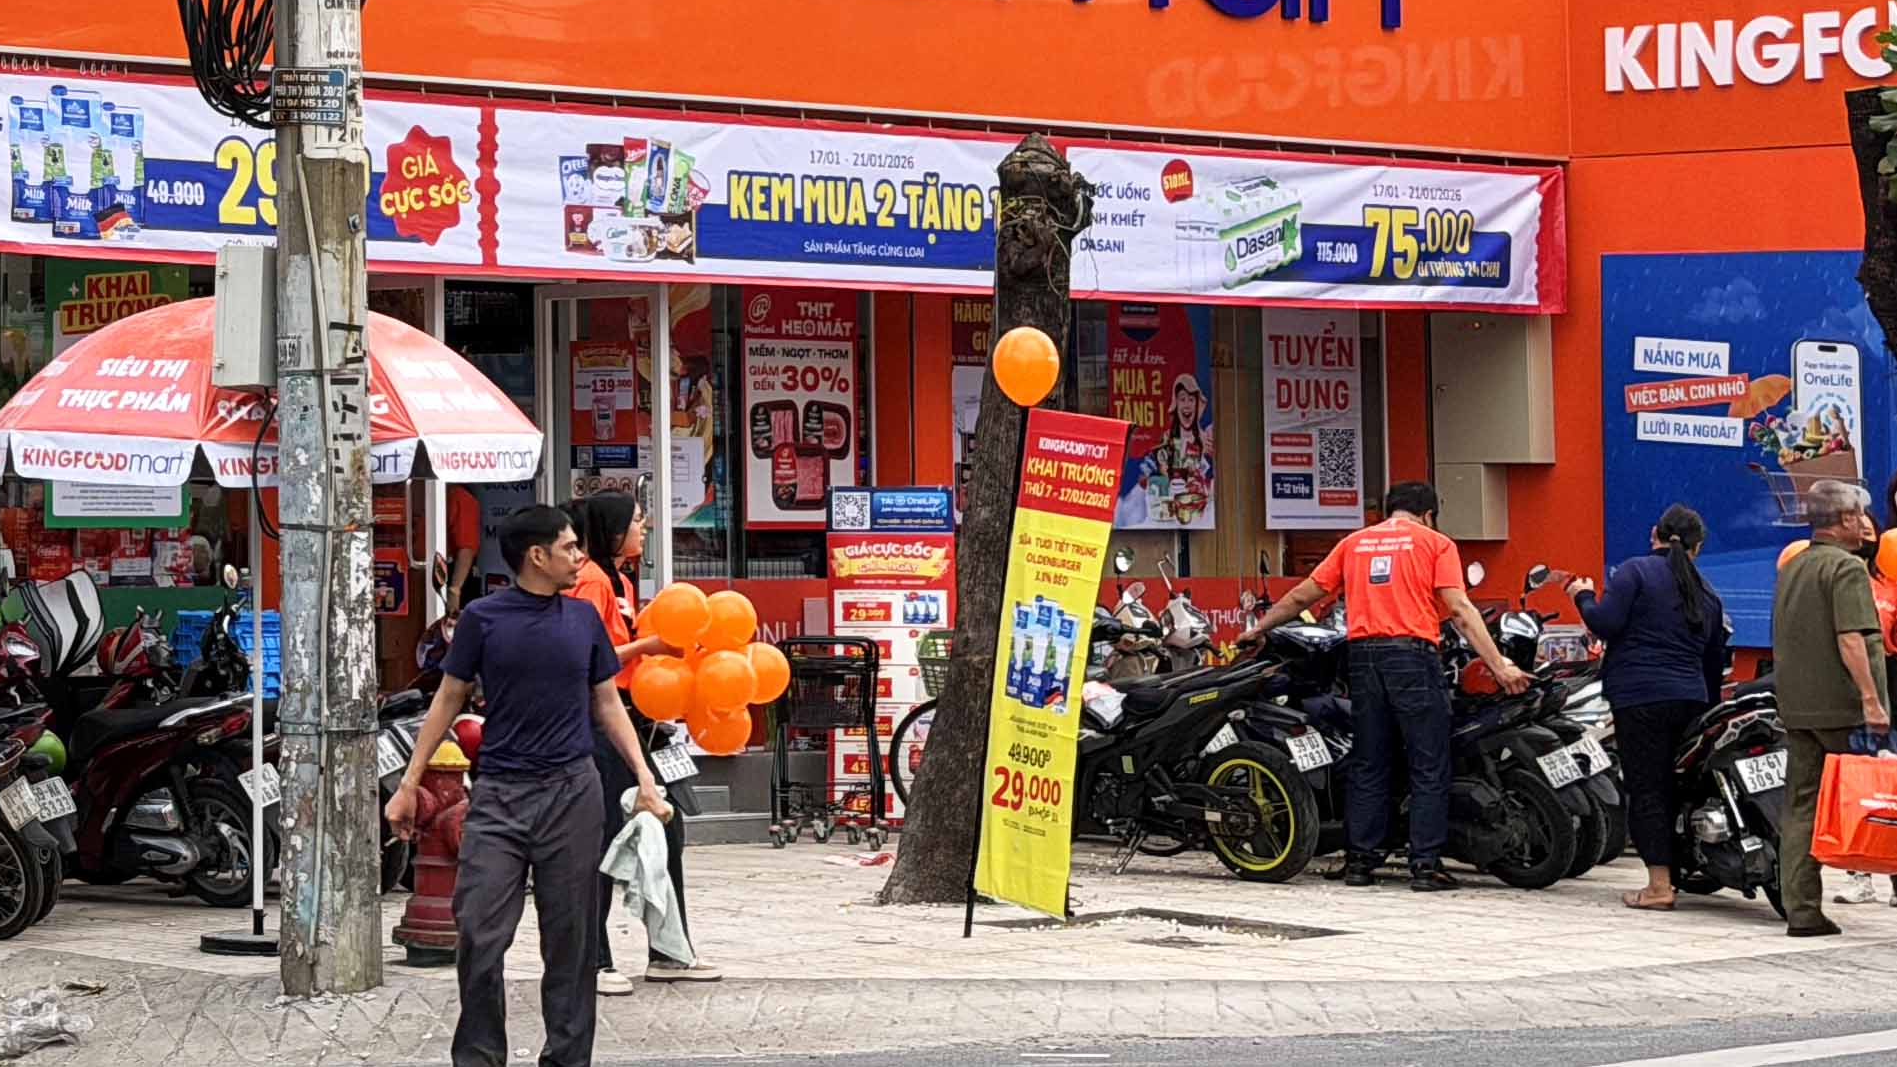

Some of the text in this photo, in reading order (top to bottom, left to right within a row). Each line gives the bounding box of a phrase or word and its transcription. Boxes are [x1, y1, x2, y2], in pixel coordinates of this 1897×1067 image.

[402, 148, 440, 179] GIÁ
[809, 149, 914, 170] 17/01 21/01/2026
[66, 196, 93, 212] Milk
[380, 179, 471, 217] CỰC SỐC
[1117, 182, 1151, 201] UỐNG
[1373, 184, 1462, 201] 17/01 21/01/2026
[729, 174, 983, 244] KEM MUA 2 TẶNG
[1111, 209, 1145, 227] KHIẾT
[804, 239, 903, 258] SẢN PHẨM TẶNG CÙNG
[1080, 237, 1124, 253] DASANI
[1364, 206, 1472, 279] 75.000
[87, 274, 149, 300] KHAI
[797, 301, 835, 318] THỊT
[782, 318, 853, 336] HEO MÁT
[817, 348, 849, 360] THƠM
[1269, 321, 1356, 368] TUYỂN
[1643, 342, 1721, 370] NẮNG MƯA
[96, 356, 191, 381] SIÊU THỊ
[781, 365, 850, 394] 30%
[1804, 372, 1853, 387] OneLife
[1113, 368, 1162, 396] MUA 2
[1628, 387, 1659, 407] VIỆC
[1689, 383, 1715, 401] CON
[1716, 375, 1745, 398] NHỎ
[58, 389, 120, 412] THỰC
[119, 385, 192, 413] PHẨM
[1276, 379, 1350, 419] DỤNG
[1159, 403, 1165, 427] 1
[1643, 416, 1671, 436] LƯỜI
[1674, 422, 1690, 437] RA
[22, 446, 185, 476] KINGFOODmart
[1026, 457, 1115, 487] KHAI TRƯƠNG
[1024, 480, 1111, 508] THỨ 7 17/01/2026
[844, 541, 933, 559] GIÁ CỰC SỐC
[1026, 552, 1081, 572] OLDENBURGER
[991, 766, 1061, 811] 29.000
